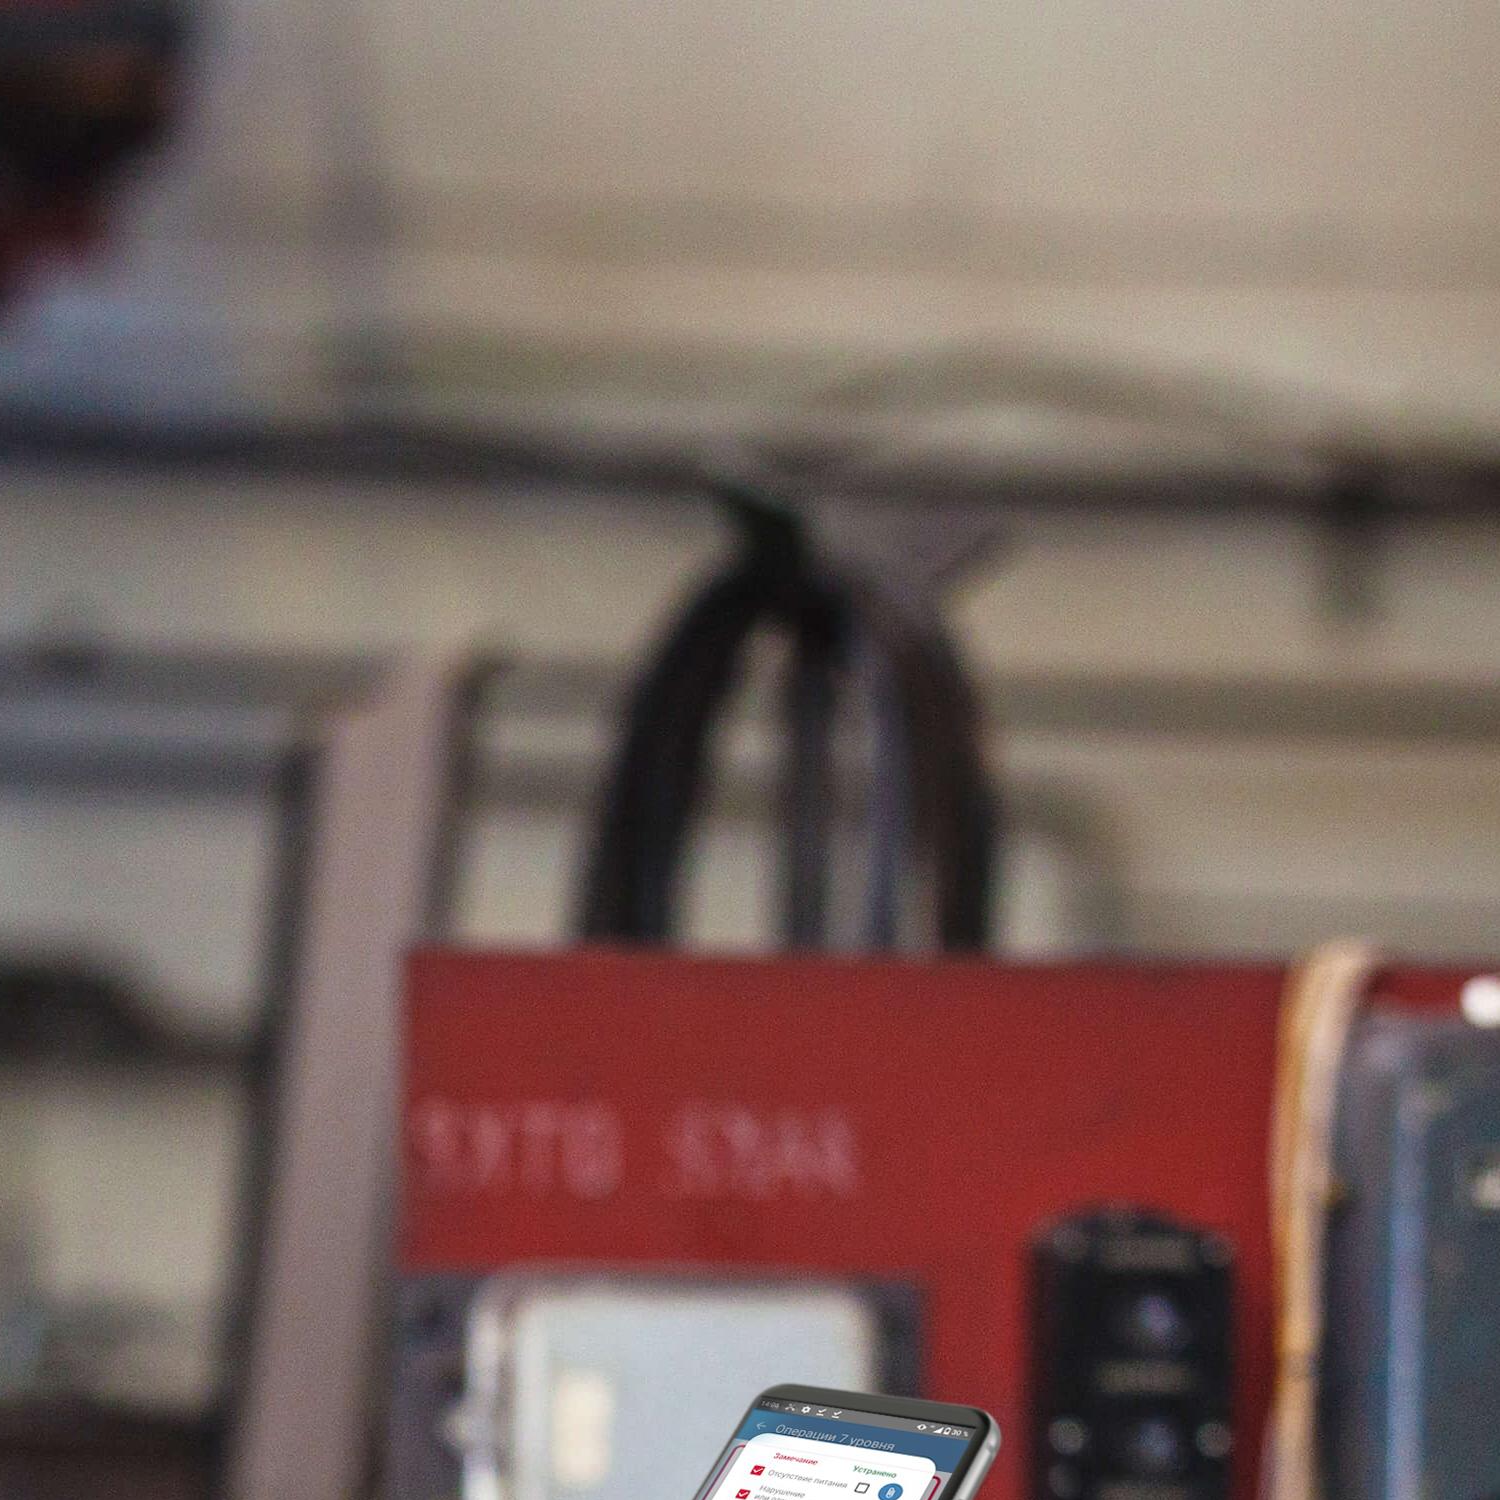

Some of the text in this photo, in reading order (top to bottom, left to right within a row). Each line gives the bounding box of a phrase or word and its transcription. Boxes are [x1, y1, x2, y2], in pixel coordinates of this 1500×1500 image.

[775, 1424, 896, 1451] Операции 7 уровня
[773, 1452, 818, 1466] Замечание
[767, 1469, 848, 1489] Отсутствие питания
[853, 1465, 897, 1479] Устранено
[759, 1485, 805, 1499] Нарушение
